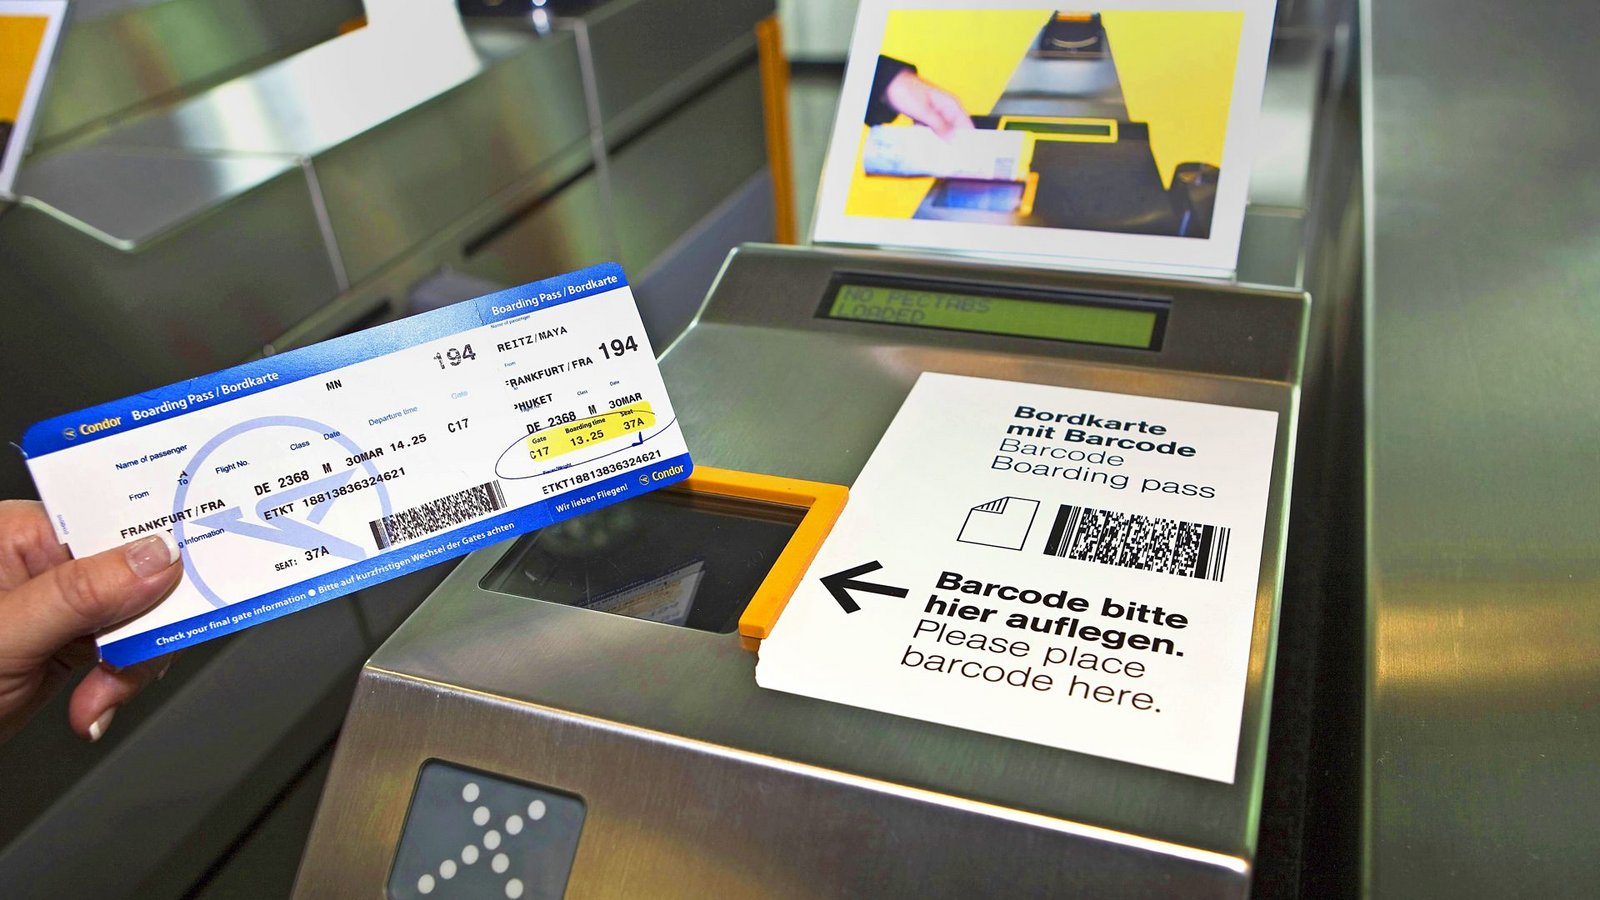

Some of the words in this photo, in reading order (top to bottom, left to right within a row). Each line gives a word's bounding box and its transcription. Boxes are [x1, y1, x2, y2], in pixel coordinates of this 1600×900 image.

[491, 297, 539, 316] Boarding
[539, 290, 562, 303] Pass
[563, 287, 567, 297] /
[567, 274, 618, 295] Bordkarte
[844, 286, 874, 302] NO
[837, 303, 926, 324] LOADED
[496, 326, 568, 353] REITZ/MAYA
[598, 335, 639, 360] 194
[433, 343, 476, 370] 194
[325, 379, 343, 392] MN
[79, 416, 122, 436] Condor
[131, 398, 188, 421] Boarding
[187, 389, 214, 409] Pass
[216, 386, 220, 398] /
[221, 371, 279, 395] Bordkarte
[368, 410, 402, 426] Departure
[403, 406, 418, 416] time
[526, 421, 542, 435] DE
[547, 411, 577, 427] 2368
[588, 404, 598, 415] M
[608, 392, 643, 409] 30MAR
[564, 421, 593, 434] Boarding
[592, 417, 606, 426] time
[623, 417, 645, 430] 37A
[1014, 405, 1168, 436] Bordkarte
[290, 440, 310, 451] Class
[323, 430, 341, 441] Date
[531, 436, 547, 445] Gate
[570, 429, 604, 447] 13.25
[1006, 424, 1056, 440] mit
[1064, 428, 1197, 458] Barcode
[115, 458, 139, 471] Name
[140, 454, 149, 463] of
[149, 443, 188, 462] passenger
[254, 482, 271, 496] DE
[277, 470, 310, 489] 2368
[322, 462, 332, 474] M
[345, 447, 384, 467] 30MAR
[390, 433, 427, 452] 14.25
[447, 418, 469, 433] C17
[529, 446, 550, 460] C17
[999, 437, 1125, 467] Barcode
[215, 462, 236, 475] Flight
[542, 449, 662, 496] ETKT18813836324621
[651, 463, 685, 482] Condor
[990, 455, 1130, 490] Boarding
[1140, 478, 1217, 499] pass
[128, 490, 150, 502] From
[177, 478, 189, 487] To
[263, 503, 295, 521] ETKT
[302, 467, 406, 508] 18813836324621
[555, 503, 571, 513] Wir
[571, 494, 597, 509] lieben
[597, 483, 629, 500] Fliegen!
[120, 498, 226, 539] FRANKFURT/FRA
[184, 528, 225, 546] Information
[274, 559, 298, 572] SEAT:
[304, 545, 330, 562] 37A
[318, 582, 339, 595] Bitte
[340, 575, 355, 587] auf
[356, 557, 411, 581] kurzfristigen
[411, 545, 446, 562] Wechsel
[446, 540, 461, 550] der
[461, 531, 486, 545] Gates
[487, 522, 515, 537] achten
[935, 571, 1090, 613] Barcode
[1100, 597, 1189, 629] bitte
[156, 631, 186, 646] Check
[186, 625, 208, 639] your
[209, 618, 231, 630] final
[232, 610, 253, 625] gate
[253, 593, 306, 616] information
[923, 594, 998, 623] hier
[1005, 612, 1185, 657] auflegen.
[912, 619, 1031, 657] Please
[1042, 646, 1146, 678] place
[900, 644, 1054, 692] barcode
[1068, 675, 1161, 713] here.
